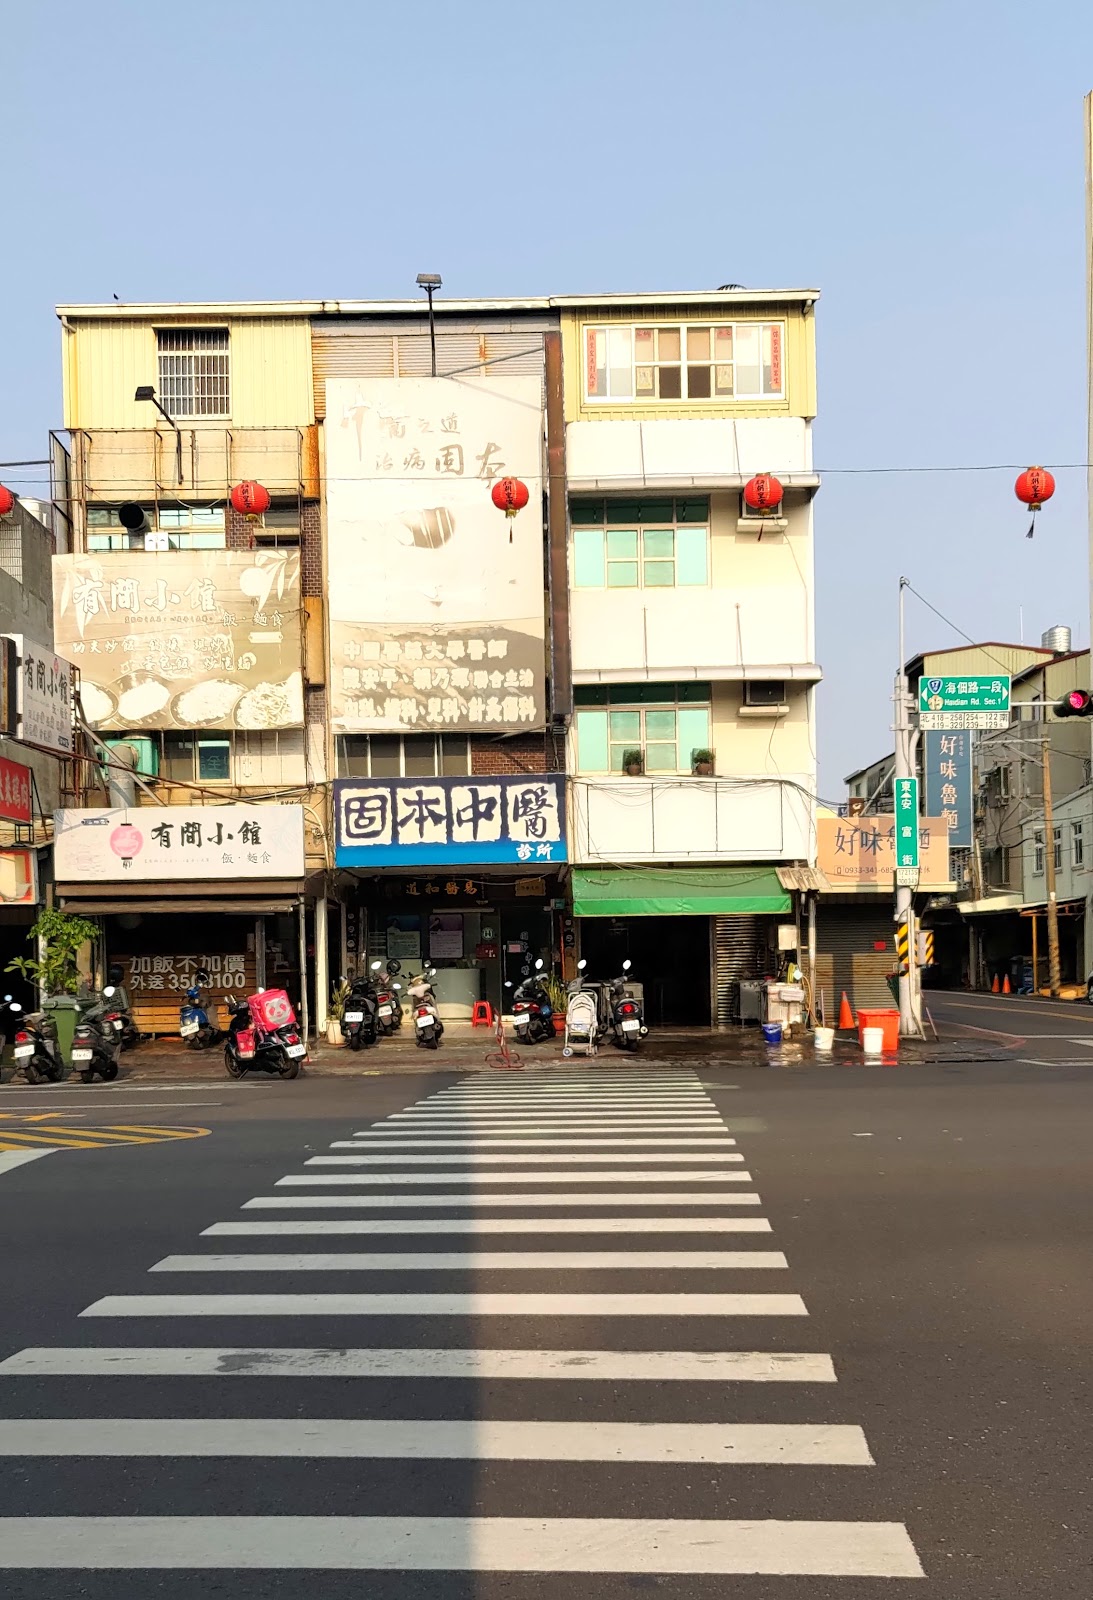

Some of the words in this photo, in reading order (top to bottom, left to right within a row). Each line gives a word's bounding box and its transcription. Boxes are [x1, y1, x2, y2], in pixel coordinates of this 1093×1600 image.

[72, 577, 217, 615] 有間小館
[945, 681, 1002, 694] 海佃路一段
[901, 781, 912, 791] 東
[345, 785, 554, 840] 固本中醫
[151, 820, 263, 848] 有間小館
[901, 799, 913, 865] 安富街
[516, 843, 553, 860] 診所
[129, 955, 246, 974] 加飯不加價
[130, 975, 165, 991] 外送
